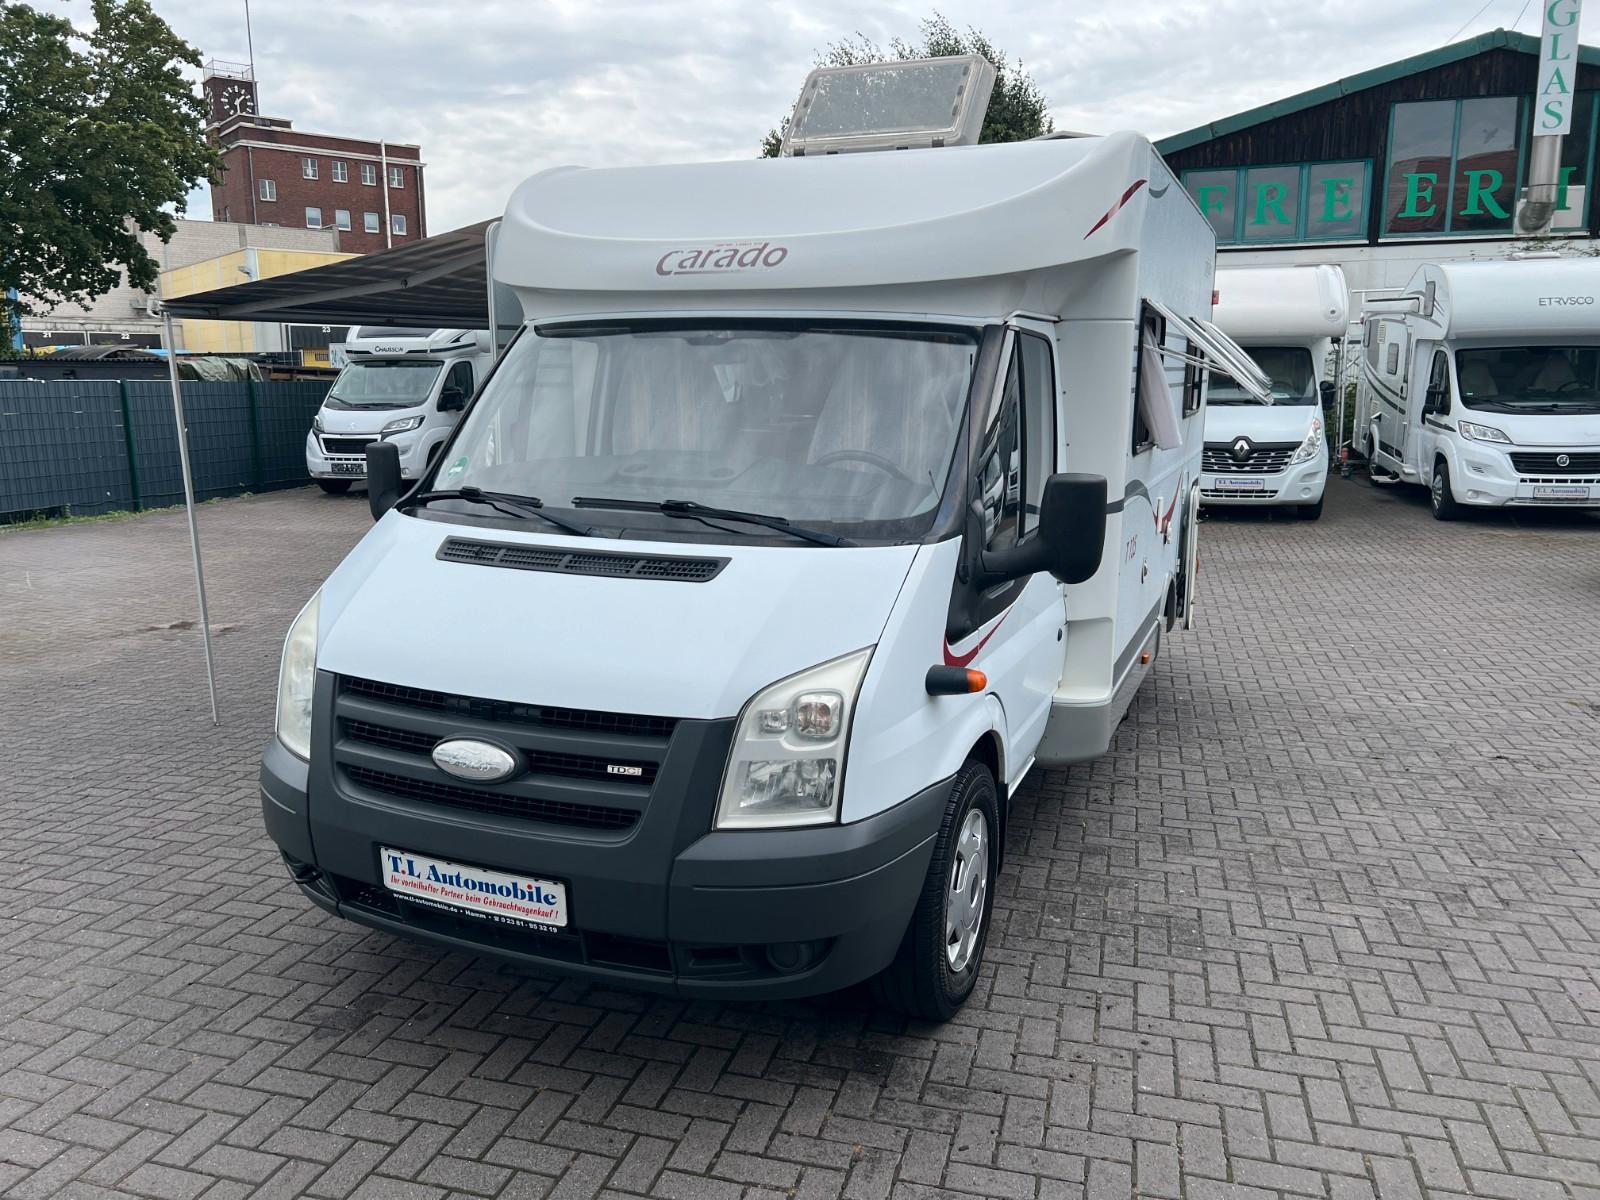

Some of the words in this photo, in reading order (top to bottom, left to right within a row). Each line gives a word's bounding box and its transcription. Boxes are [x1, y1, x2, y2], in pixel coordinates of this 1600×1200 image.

[1541, 0, 1579, 129] GLAS
[391, 874, 400, 884] Ihr
[401, 879, 439, 894] vorteilhafter
[440, 886, 464, 900] Partner
[465, 892, 481, 903] beim
[483, 896, 554, 918] Gebrauchtwagenkauf
[426, 863, 558, 906] Automobile
[465, 909, 487, 919] Hamm
